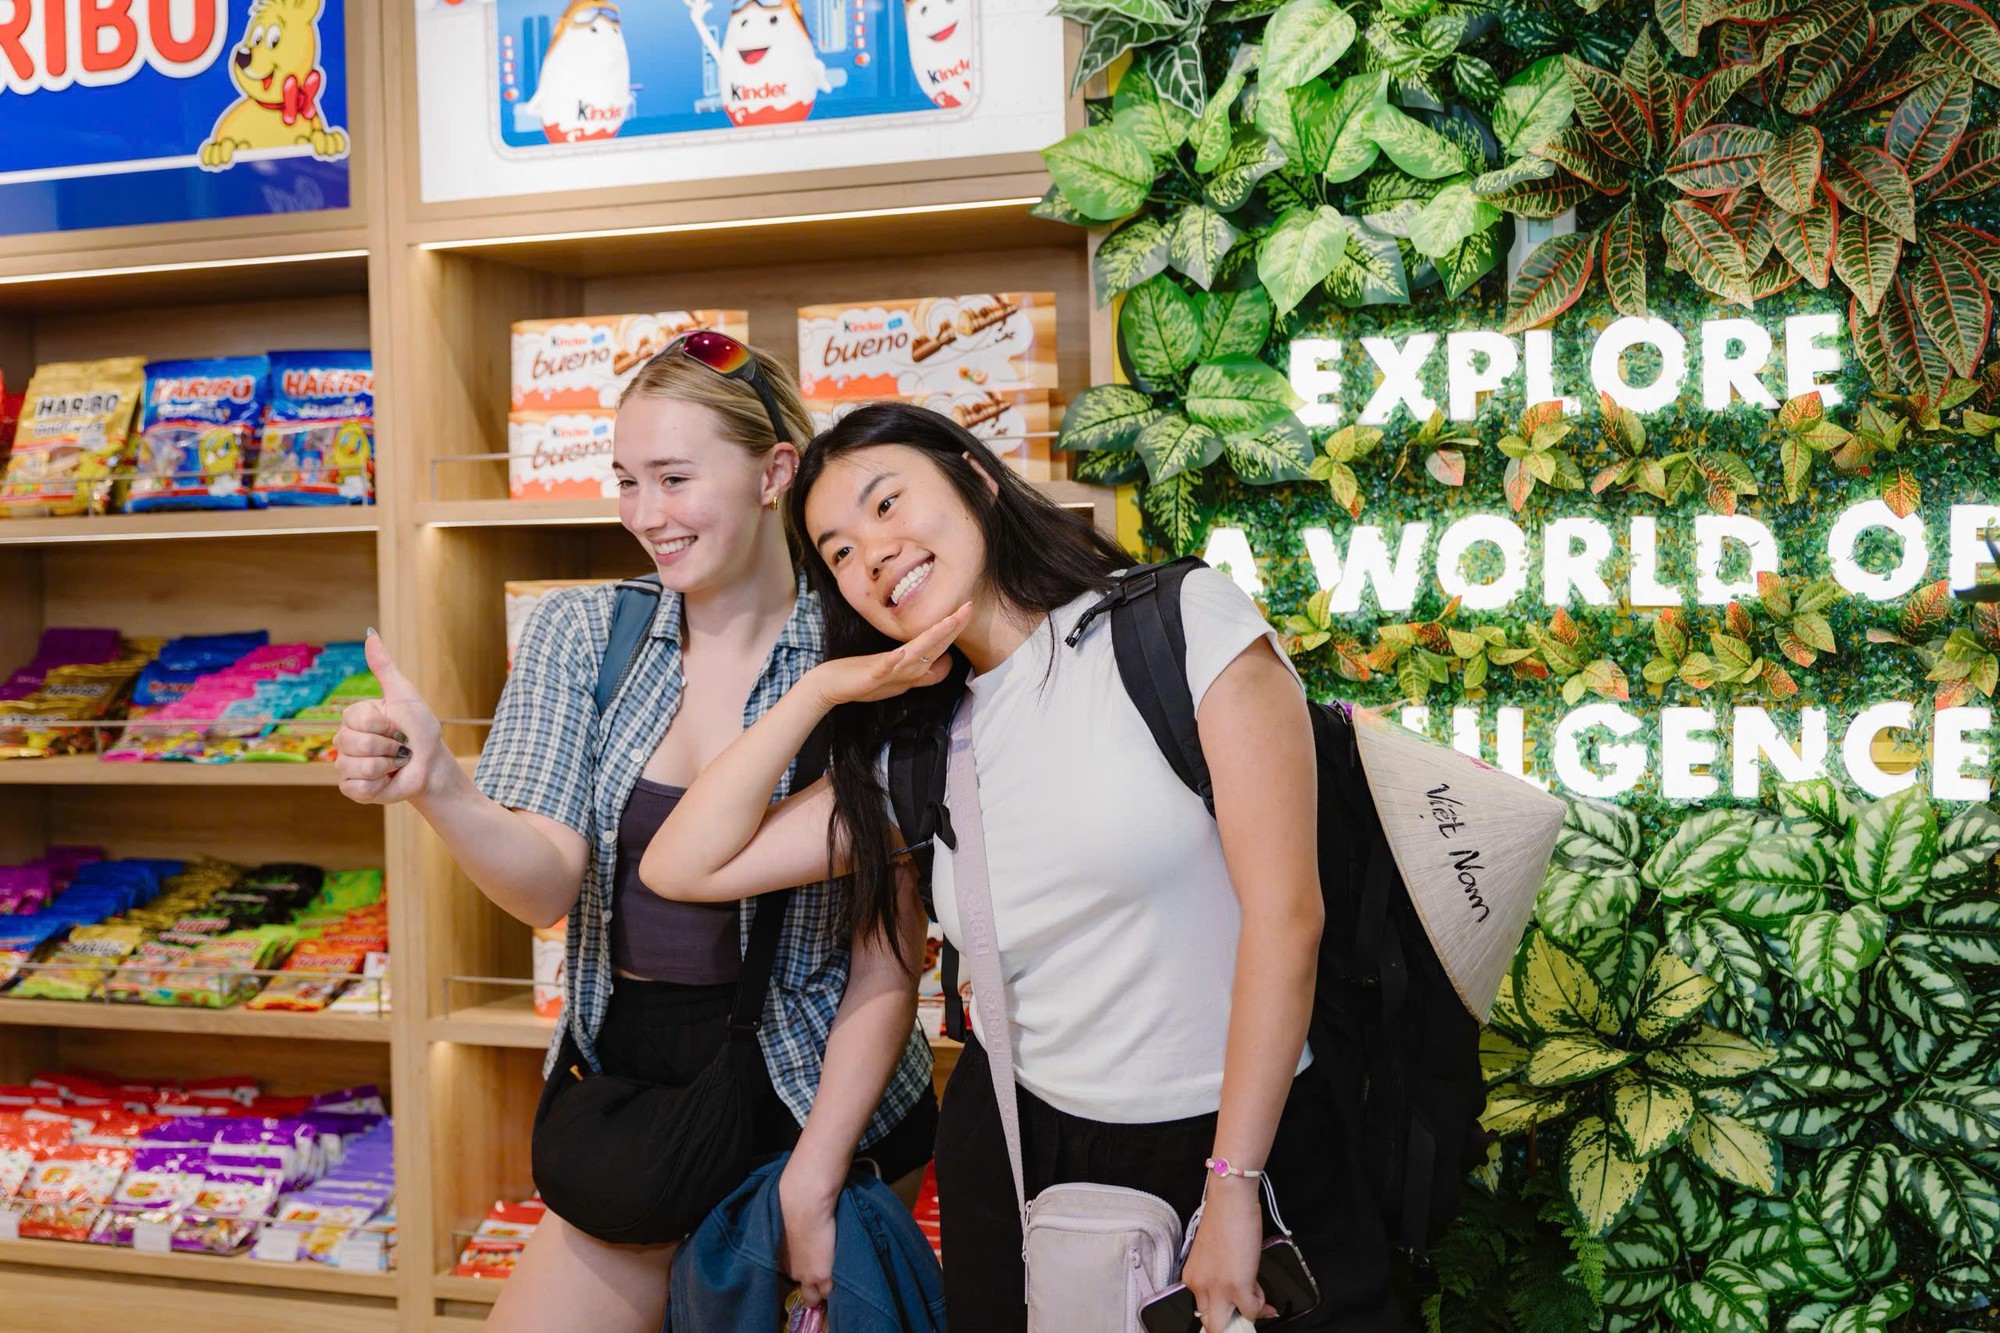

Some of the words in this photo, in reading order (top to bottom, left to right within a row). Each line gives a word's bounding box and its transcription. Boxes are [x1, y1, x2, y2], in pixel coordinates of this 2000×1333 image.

[532, 348, 610, 379] bueno
[823, 332, 908, 366] bueno
[285, 372, 375, 398] HARIB
[1290, 316, 1842, 426] EXPLORE
[38, 394, 119, 416] HARBO
[1203, 527, 1266, 602] A
[1302, 513, 1779, 613] WORLD
[1828, 499, 2000, 601] OF
[1449, 850, 1490, 923] Nam
